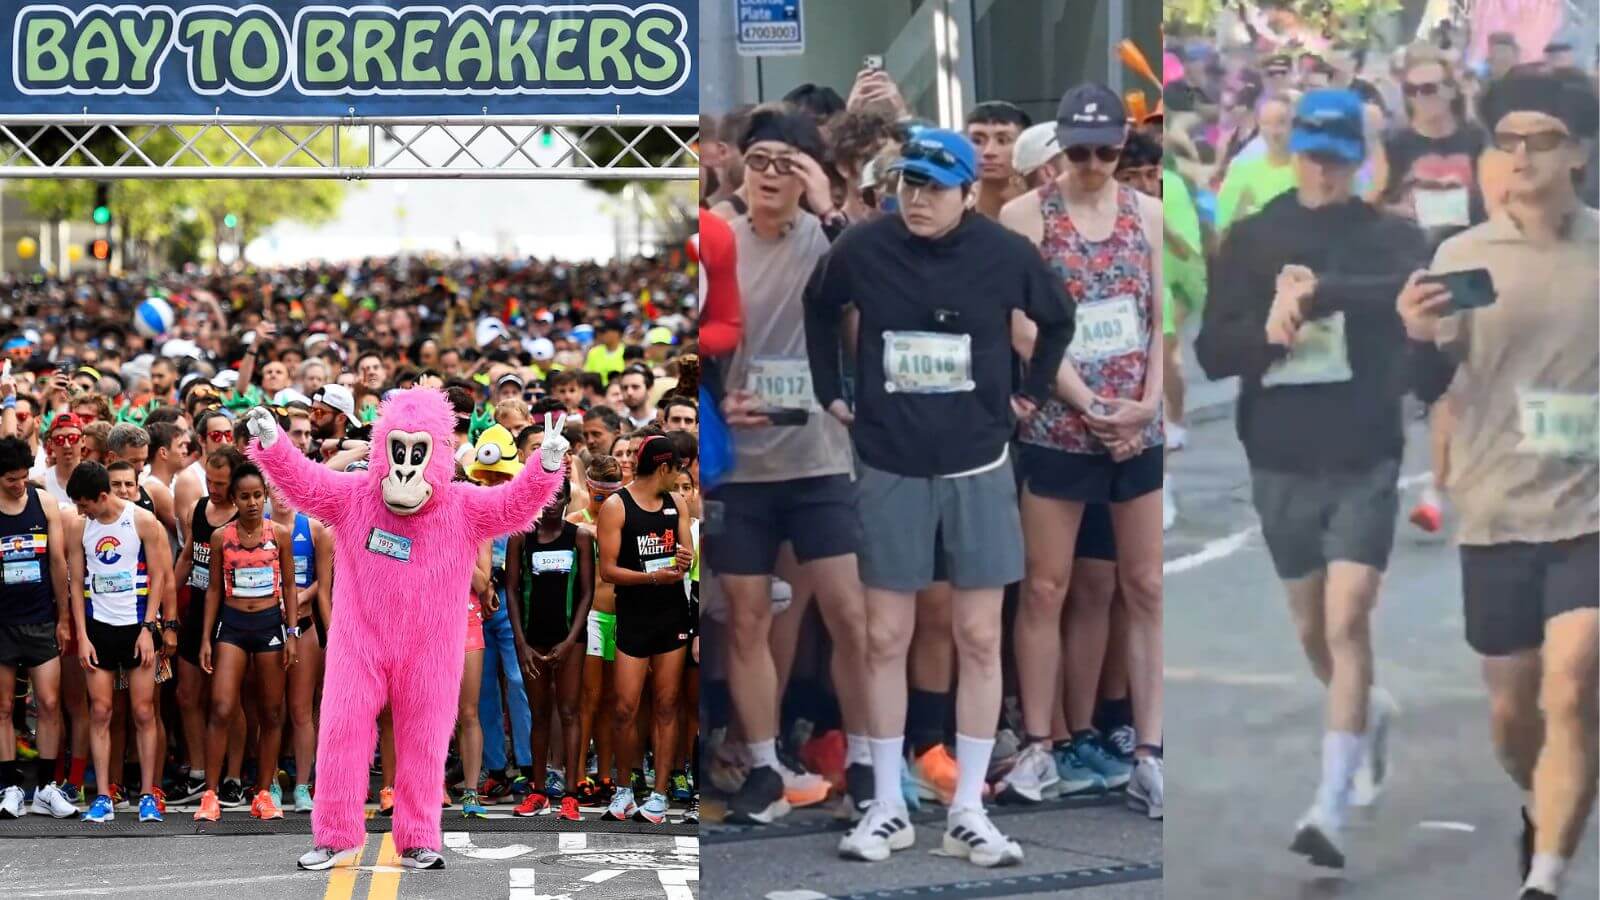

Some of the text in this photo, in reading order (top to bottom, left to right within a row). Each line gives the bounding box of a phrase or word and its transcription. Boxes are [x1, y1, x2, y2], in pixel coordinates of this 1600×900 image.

[740, 7, 772, 21] Plate
[26, 17, 678, 82] BAY TO BREAKERS
[378, 539, 395, 550] 1912
[637, 535, 659, 549] WEST
